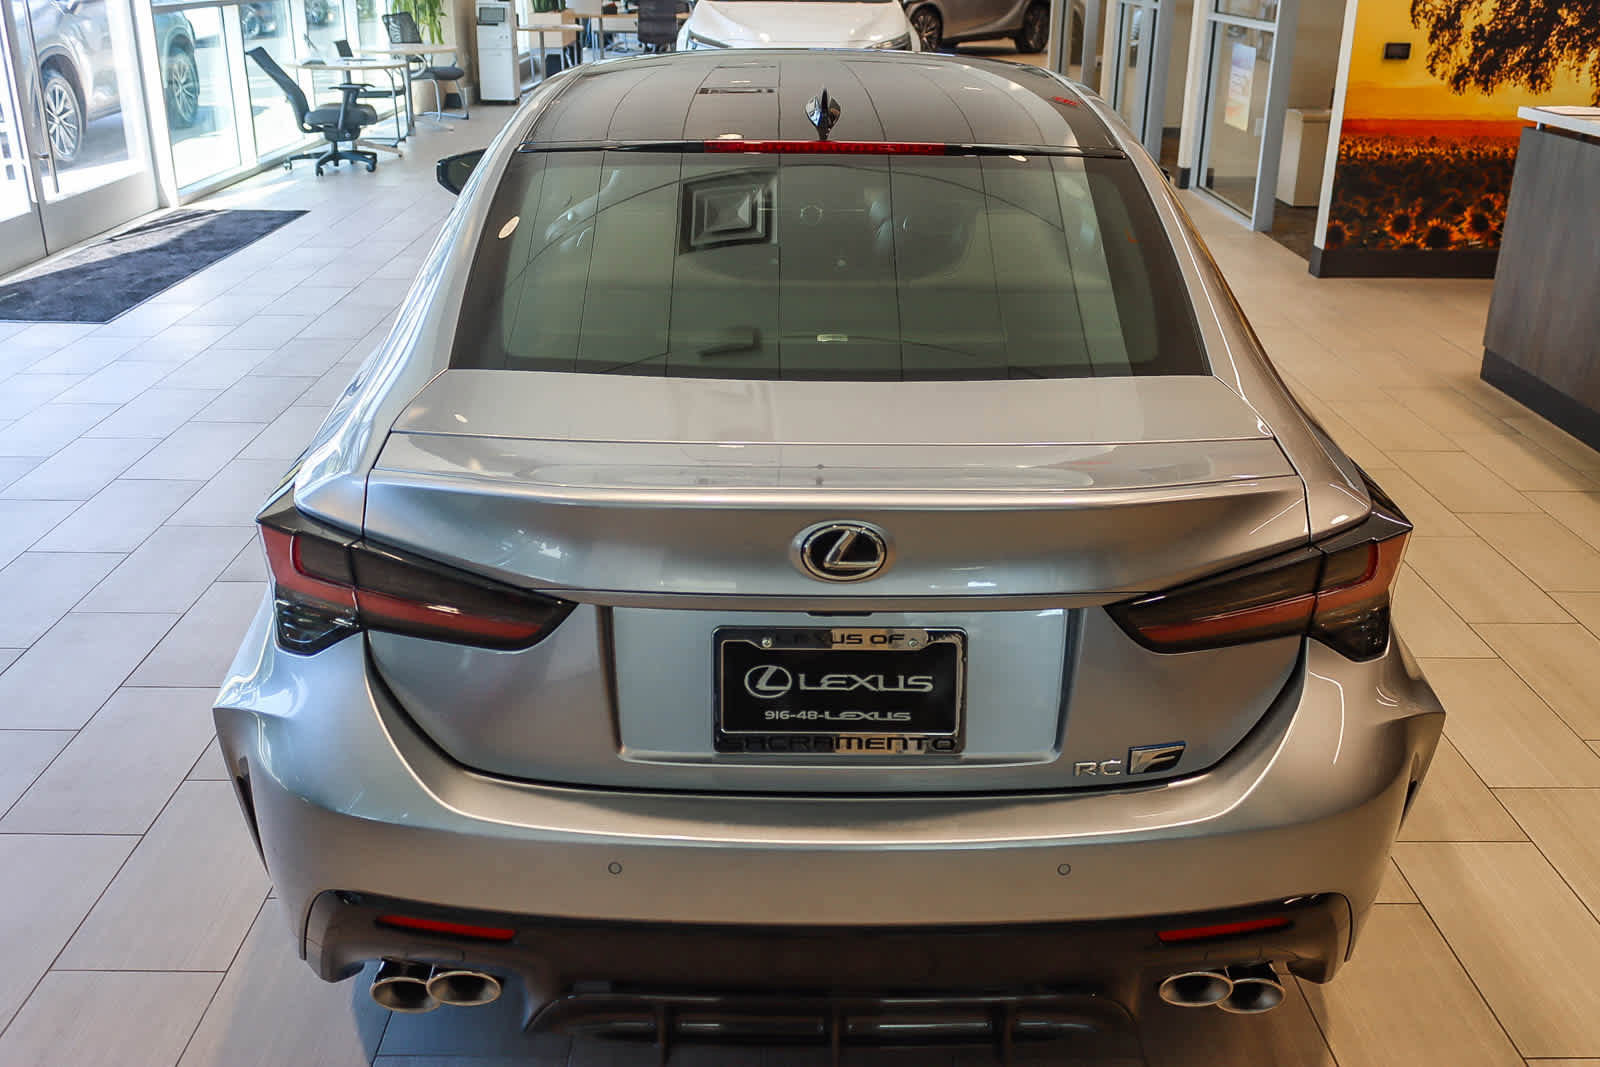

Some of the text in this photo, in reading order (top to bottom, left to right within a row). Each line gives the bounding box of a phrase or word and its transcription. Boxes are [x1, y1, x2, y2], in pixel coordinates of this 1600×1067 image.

[870, 634, 905, 645] OF
[799, 674, 934, 693] LEXUS
[764, 710, 912, 721] 916-48-LEXUS
[1073, 760, 1121, 776] RC
